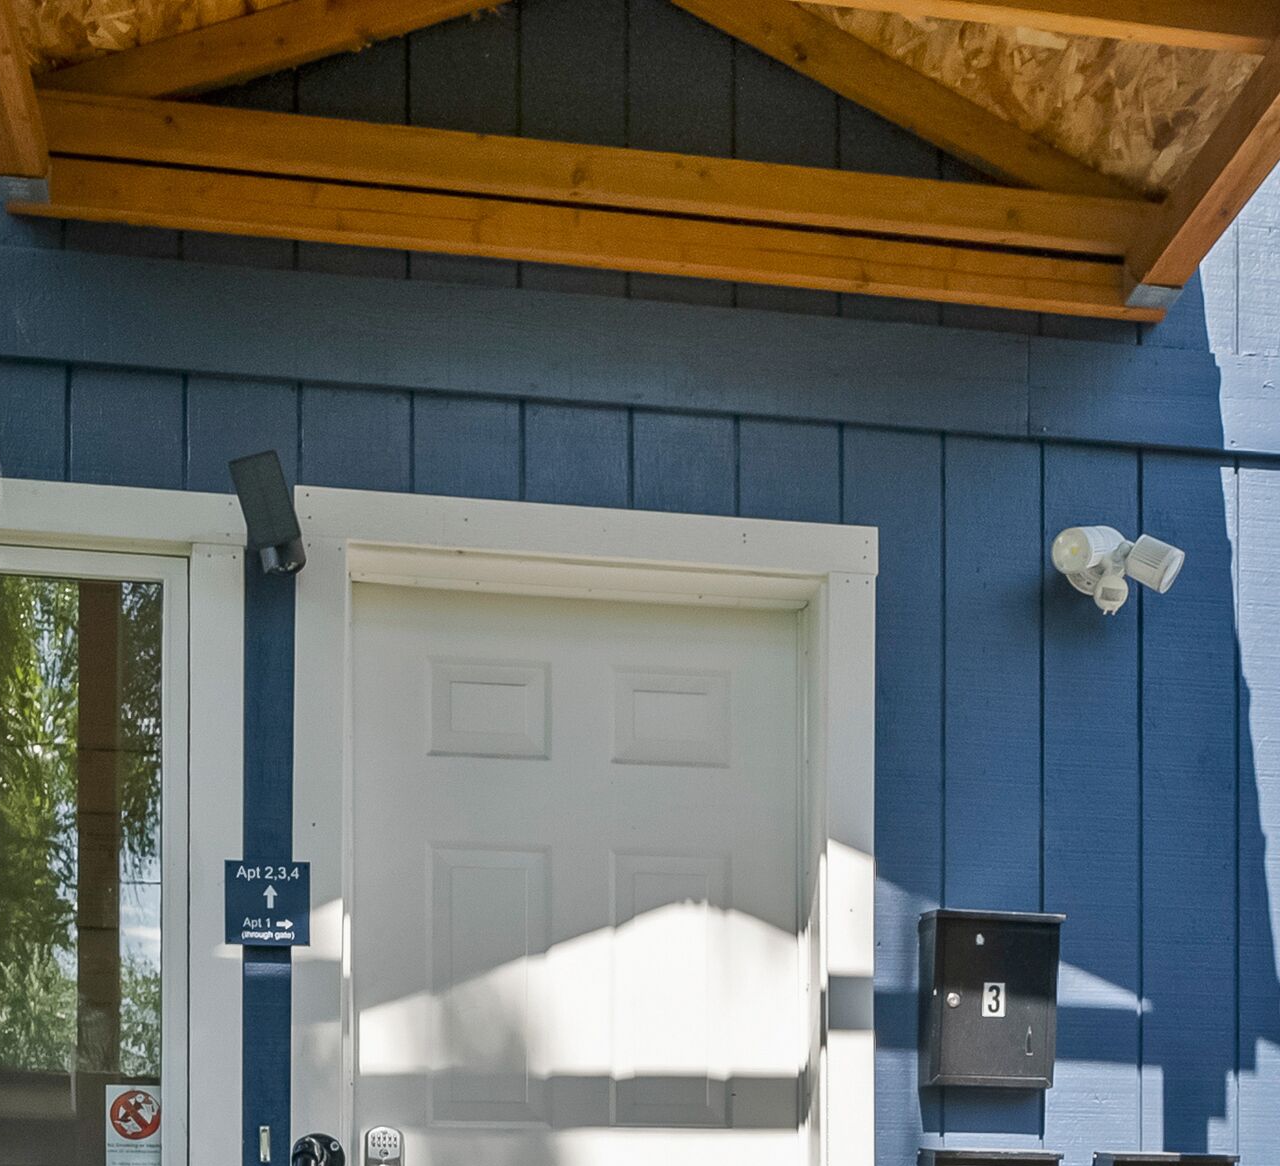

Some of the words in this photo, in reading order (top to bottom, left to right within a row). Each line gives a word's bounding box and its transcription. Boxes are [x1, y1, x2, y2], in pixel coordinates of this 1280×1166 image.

[236, 865, 261, 881] Apt
[264, 866, 300, 881] 2,3,4
[242, 917, 262, 929] Apt
[265, 918, 271, 928] 1
[987, 985, 1001, 1013] 3
